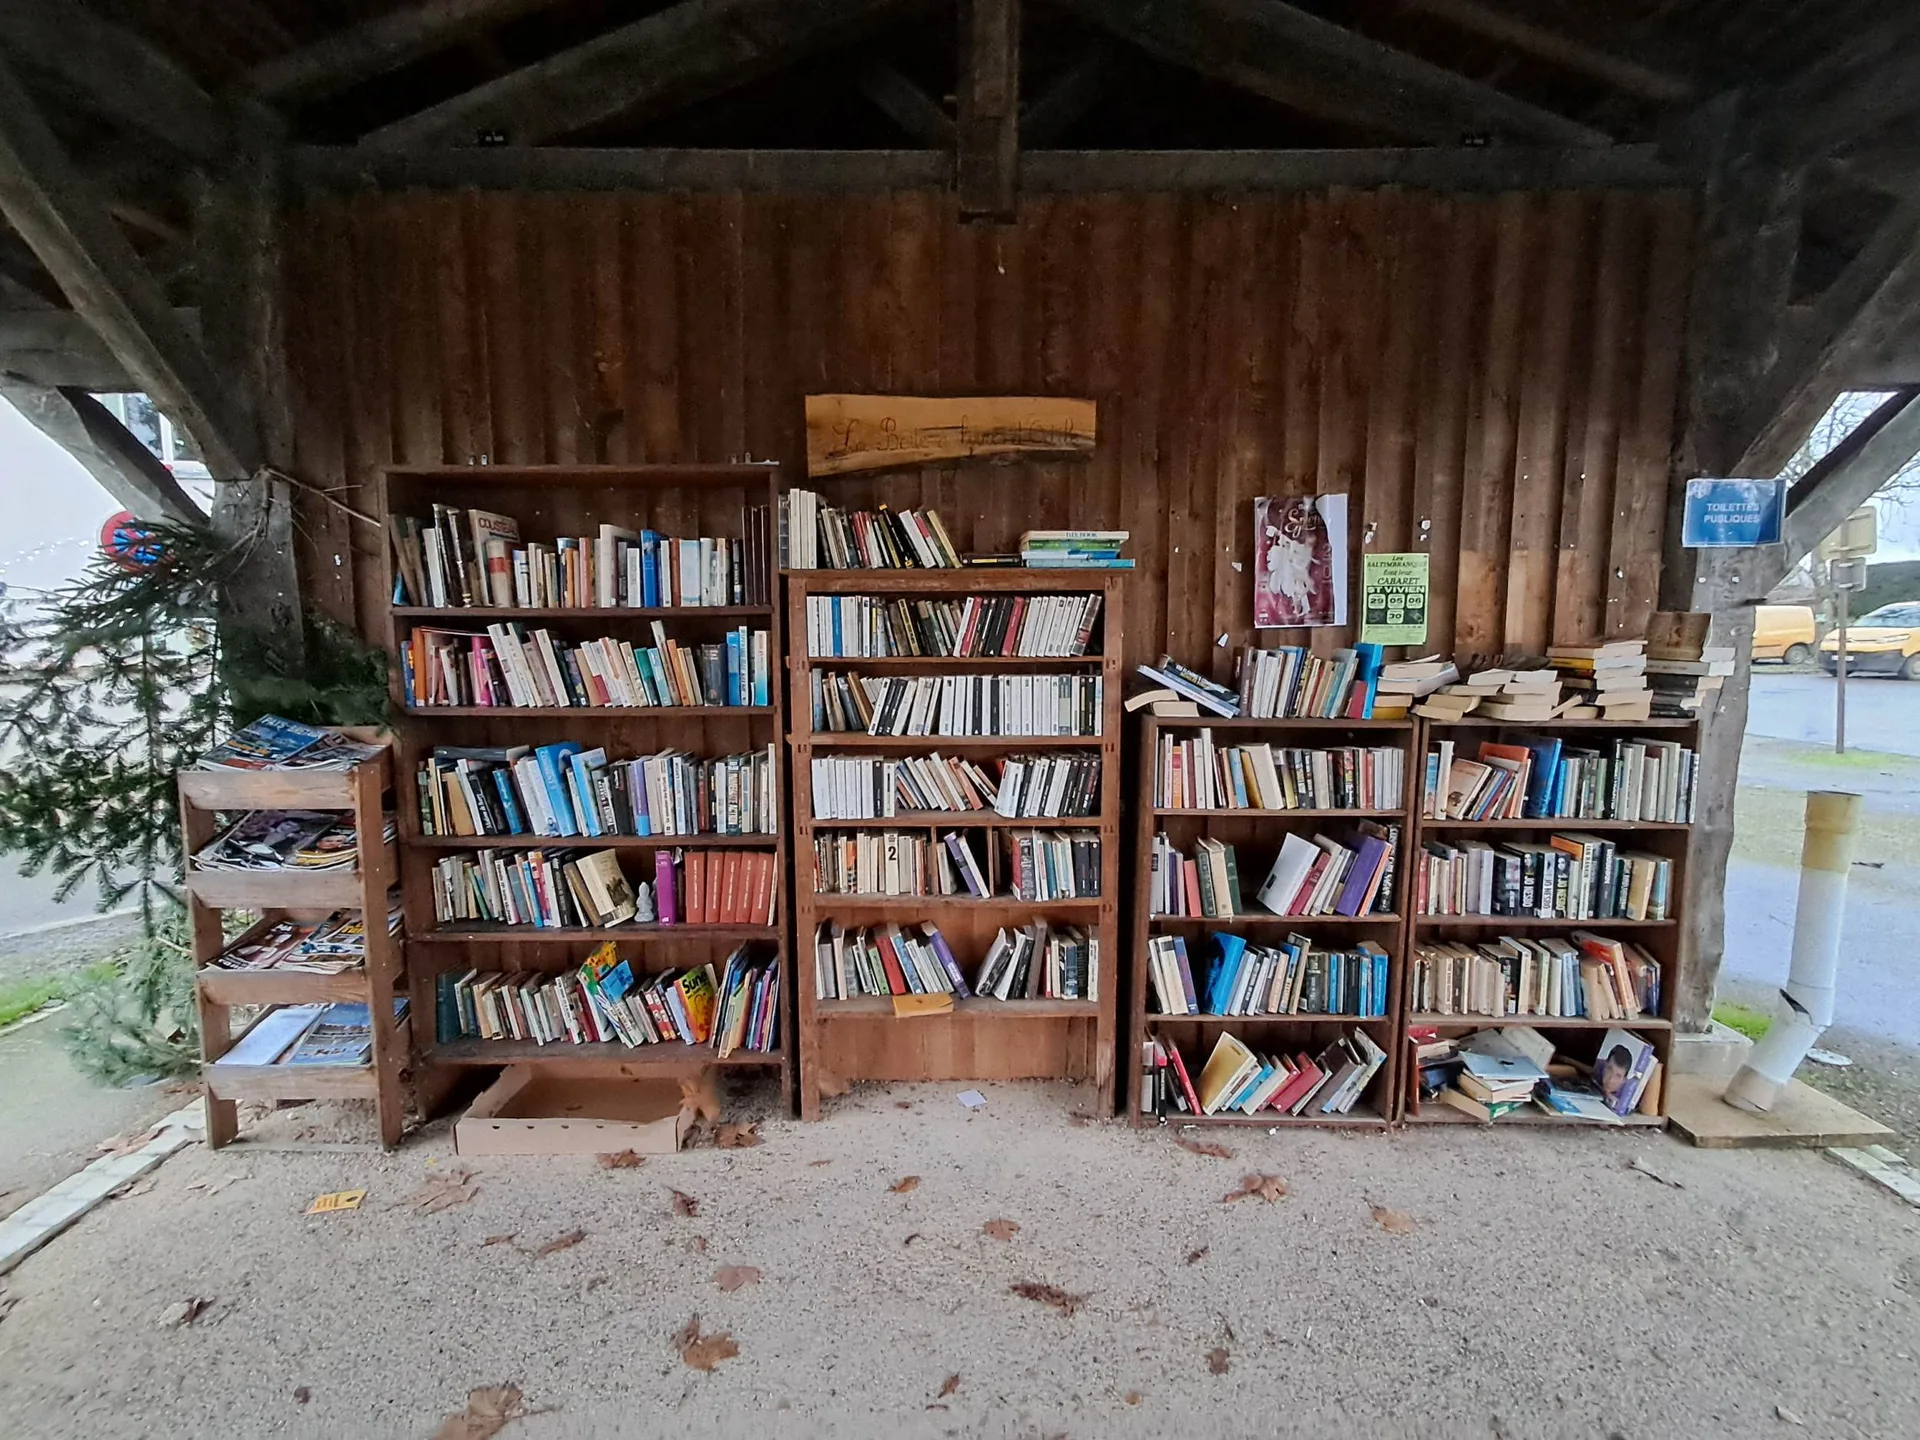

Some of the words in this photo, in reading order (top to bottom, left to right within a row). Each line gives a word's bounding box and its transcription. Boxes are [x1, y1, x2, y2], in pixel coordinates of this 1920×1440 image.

[1706, 503, 1760, 512] TOILETTES
[1703, 514, 1761, 523] PUBLIQUES
[1377, 577, 1420, 585] CABARET
[887, 845, 896, 860] 2
